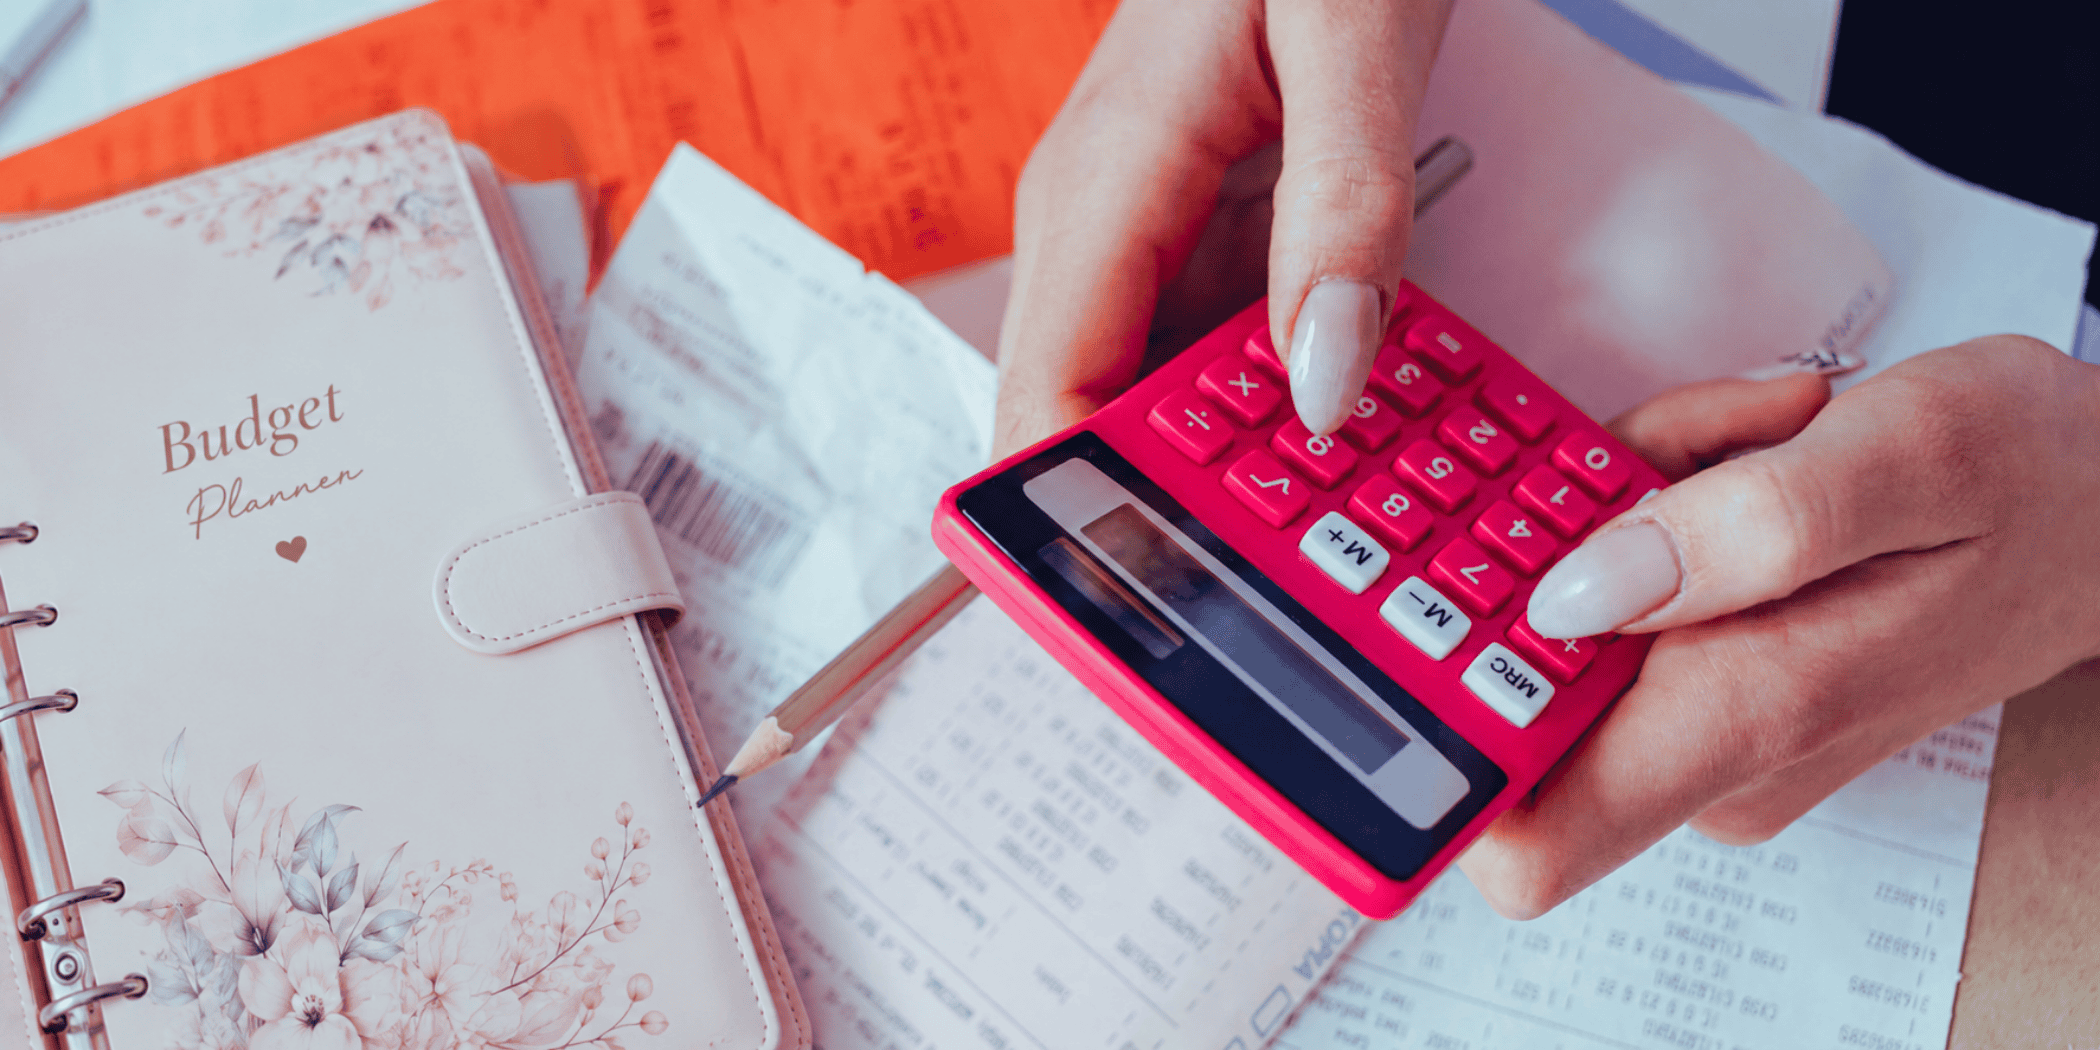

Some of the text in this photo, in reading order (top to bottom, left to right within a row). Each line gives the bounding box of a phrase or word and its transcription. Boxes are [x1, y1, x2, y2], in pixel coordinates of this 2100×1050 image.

[1395, 363, 1421, 385] 3
[1352, 396, 1378, 418] 6
[157, 383, 345, 475] Budget
[1469, 419, 1498, 444] 2
[1306, 434, 1334, 456] 9
[1425, 457, 1454, 479] 5
[1585, 447, 1610, 470] 0
[186, 469, 364, 540] Planner
[1382, 493, 1410, 517] 8
[1550, 485, 1569, 505] 1
[1508, 519, 1532, 537] 4
[1328, 529, 1373, 566] M+
[1460, 563, 1489, 585] 7
[1490, 657, 1540, 699] MRC
